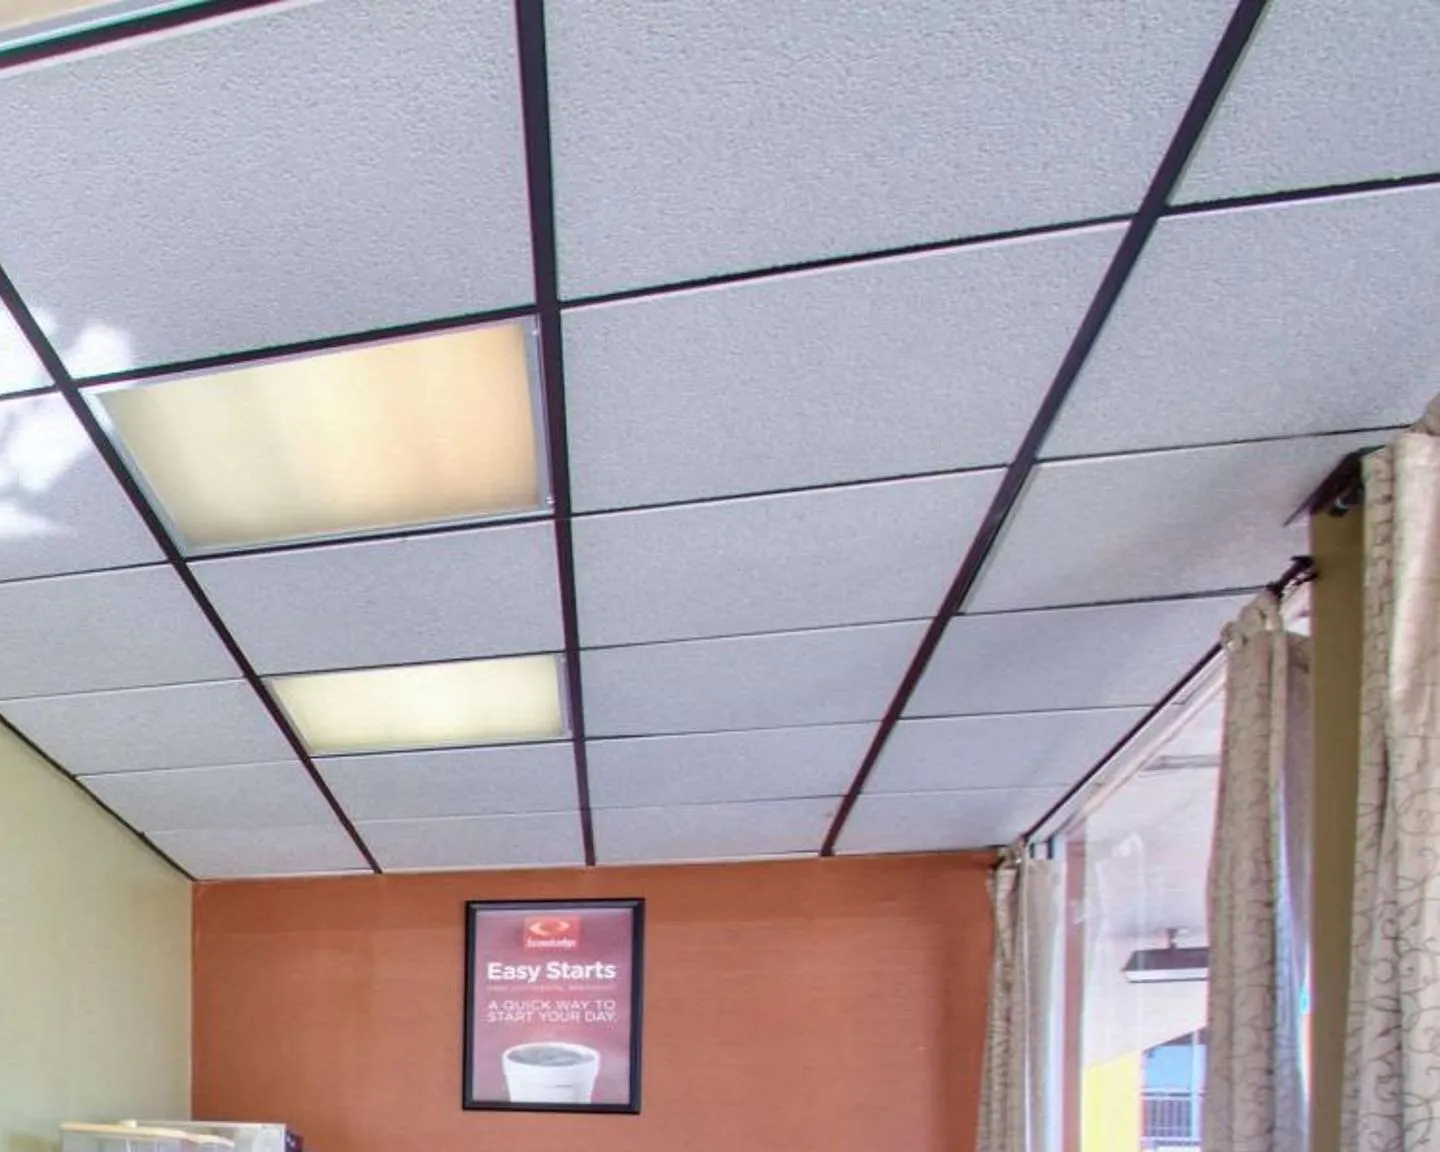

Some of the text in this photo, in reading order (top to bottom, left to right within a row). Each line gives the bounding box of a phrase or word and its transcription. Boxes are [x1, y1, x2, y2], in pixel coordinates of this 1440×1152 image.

[487, 961, 616, 983] Easy Starts
[488, 999, 616, 1011] A QUICK WAY TO
[487, 1011, 533, 1022] START
[539, 1011, 580, 1022] YOUR
